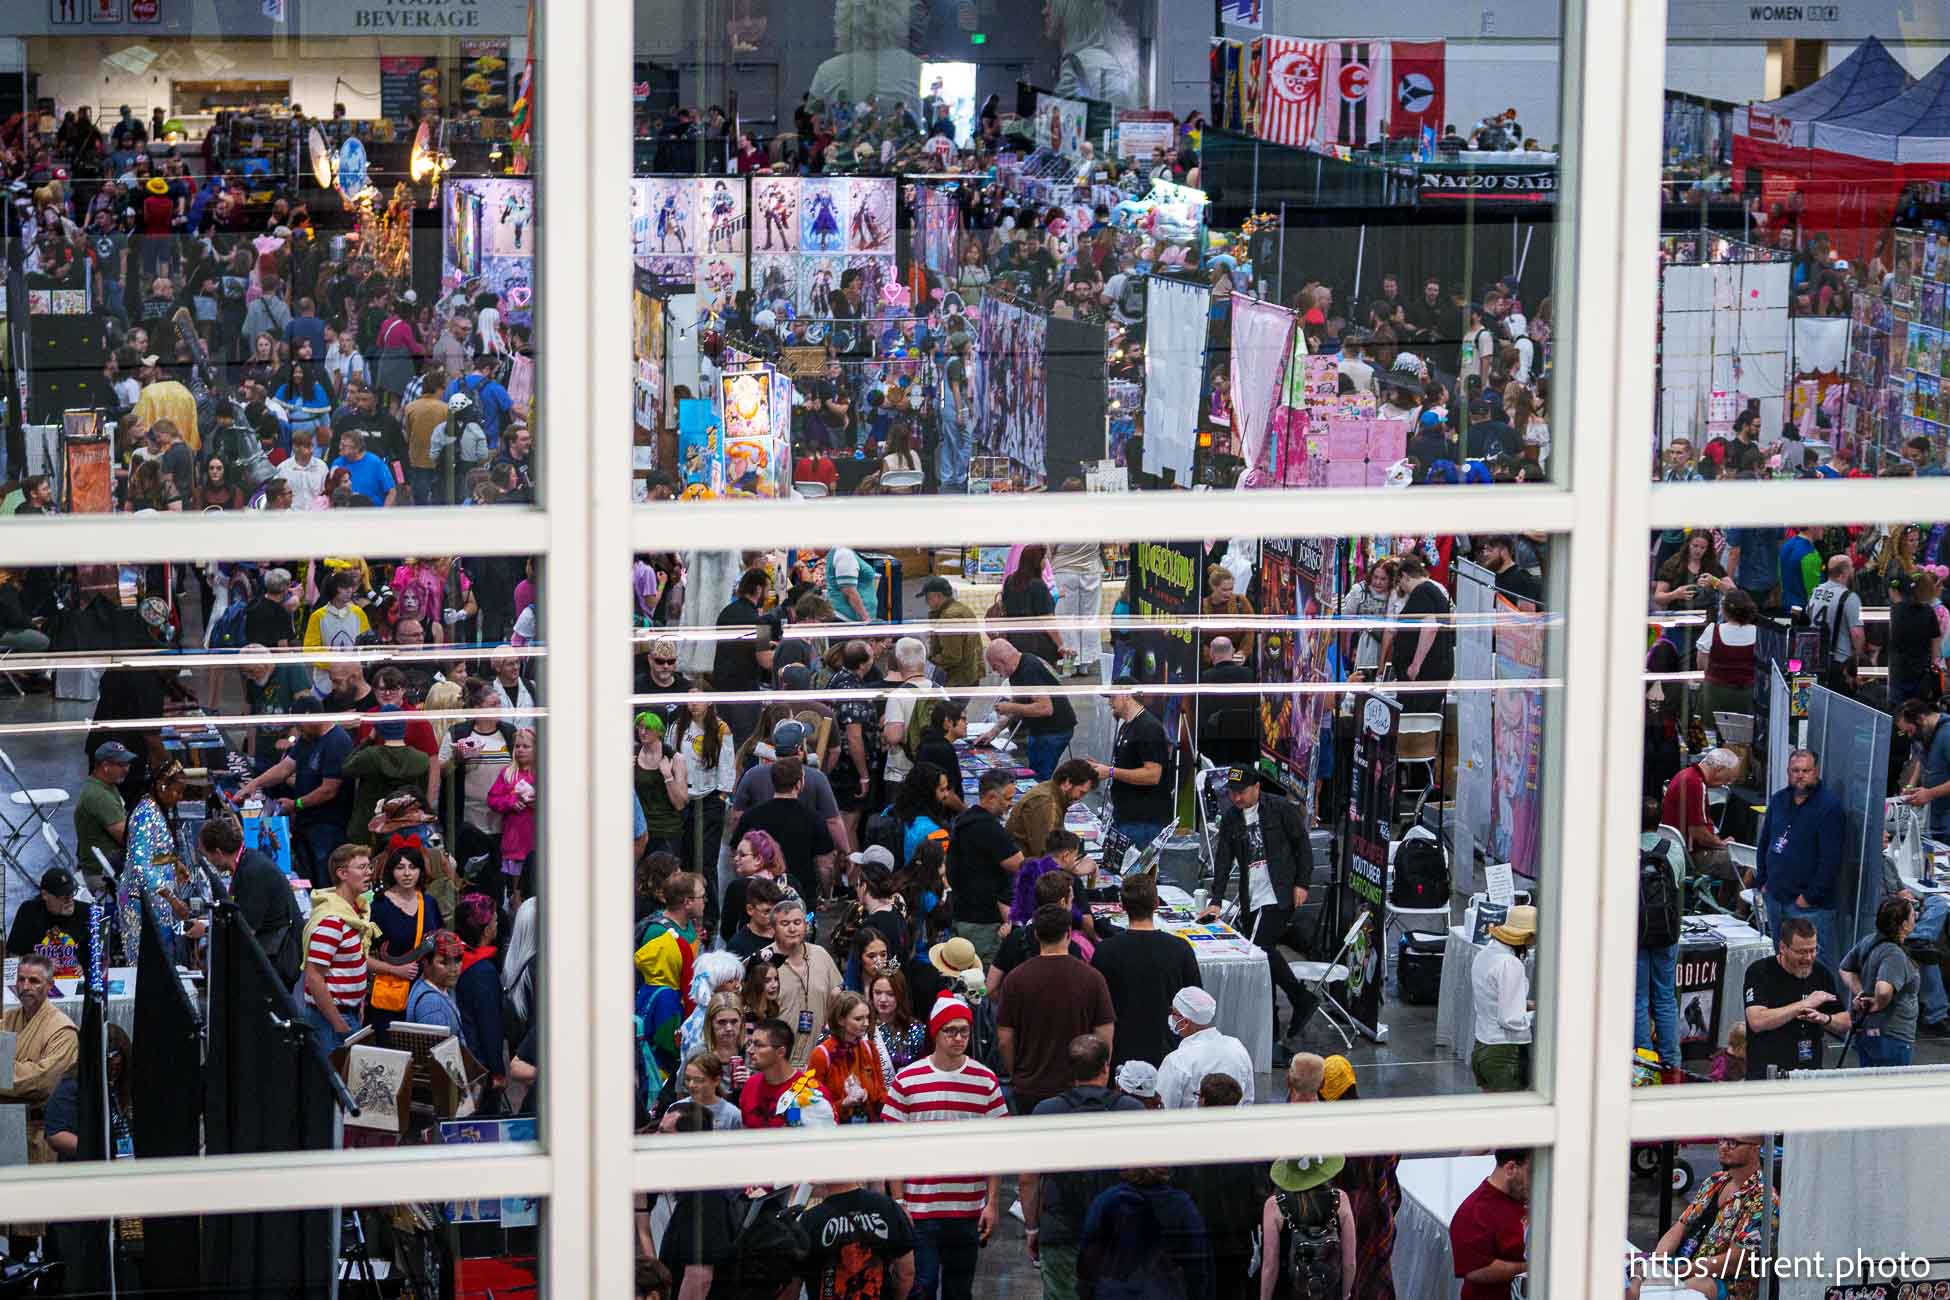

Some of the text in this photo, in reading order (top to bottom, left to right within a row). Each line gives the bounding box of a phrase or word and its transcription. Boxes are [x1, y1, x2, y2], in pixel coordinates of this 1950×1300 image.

[354, 10, 480, 27] BEVERAGE
[1750, 6, 1803, 21] WOMEN
[1352, 853, 1382, 885] YOUTUBER
